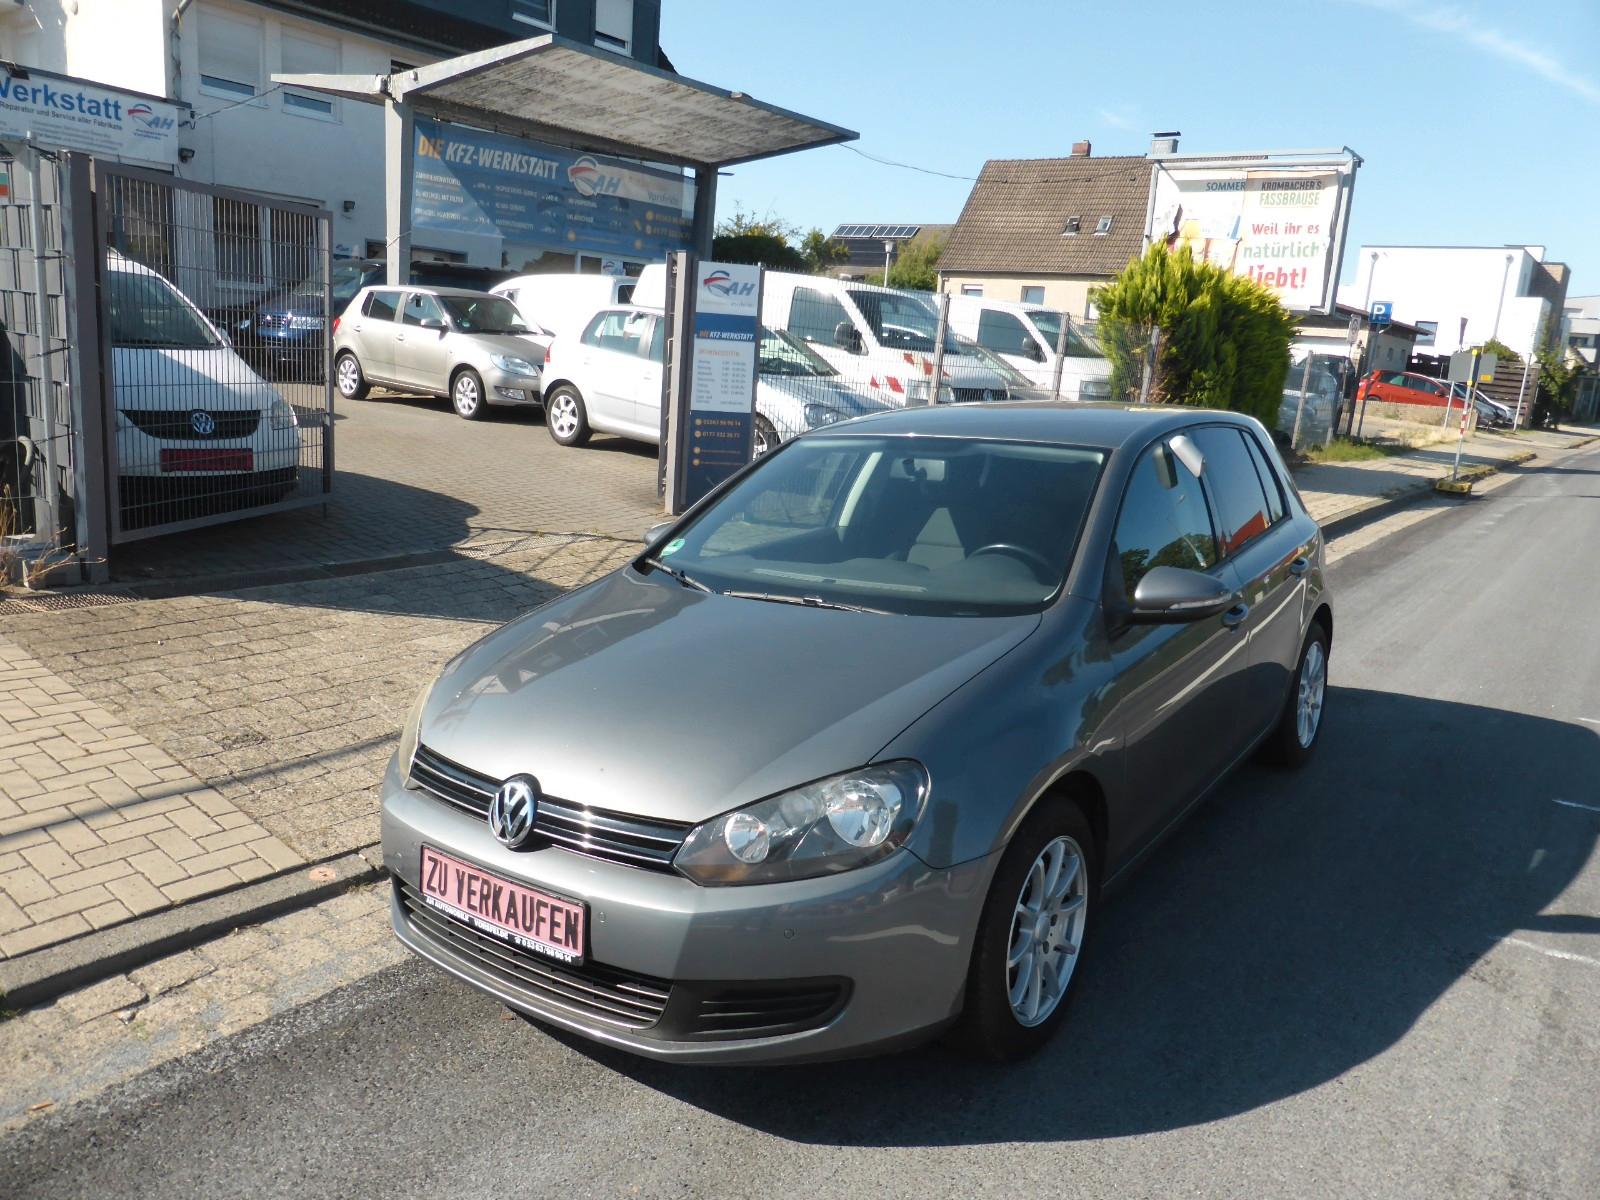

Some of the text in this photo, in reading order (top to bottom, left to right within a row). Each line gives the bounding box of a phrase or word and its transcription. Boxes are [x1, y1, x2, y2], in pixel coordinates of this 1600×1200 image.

[150, 116, 174, 129] AH
[417, 135, 444, 160] DIE
[445, 141, 559, 180] KFZ-WERKSTATT
[1206, 181, 1246, 192] SOMMER
[1259, 192, 1320, 206] FASSBRAUSE
[1252, 222, 1320, 235] Weil ihr es
[1243, 241, 1320, 258] natürlich
[727, 281, 756, 296] AH
[1373, 304, 1385, 320] P
[710, 331, 754, 341] KFZ-WERKSTATT
[427, 856, 579, 950] ZU VERKAUFEN
